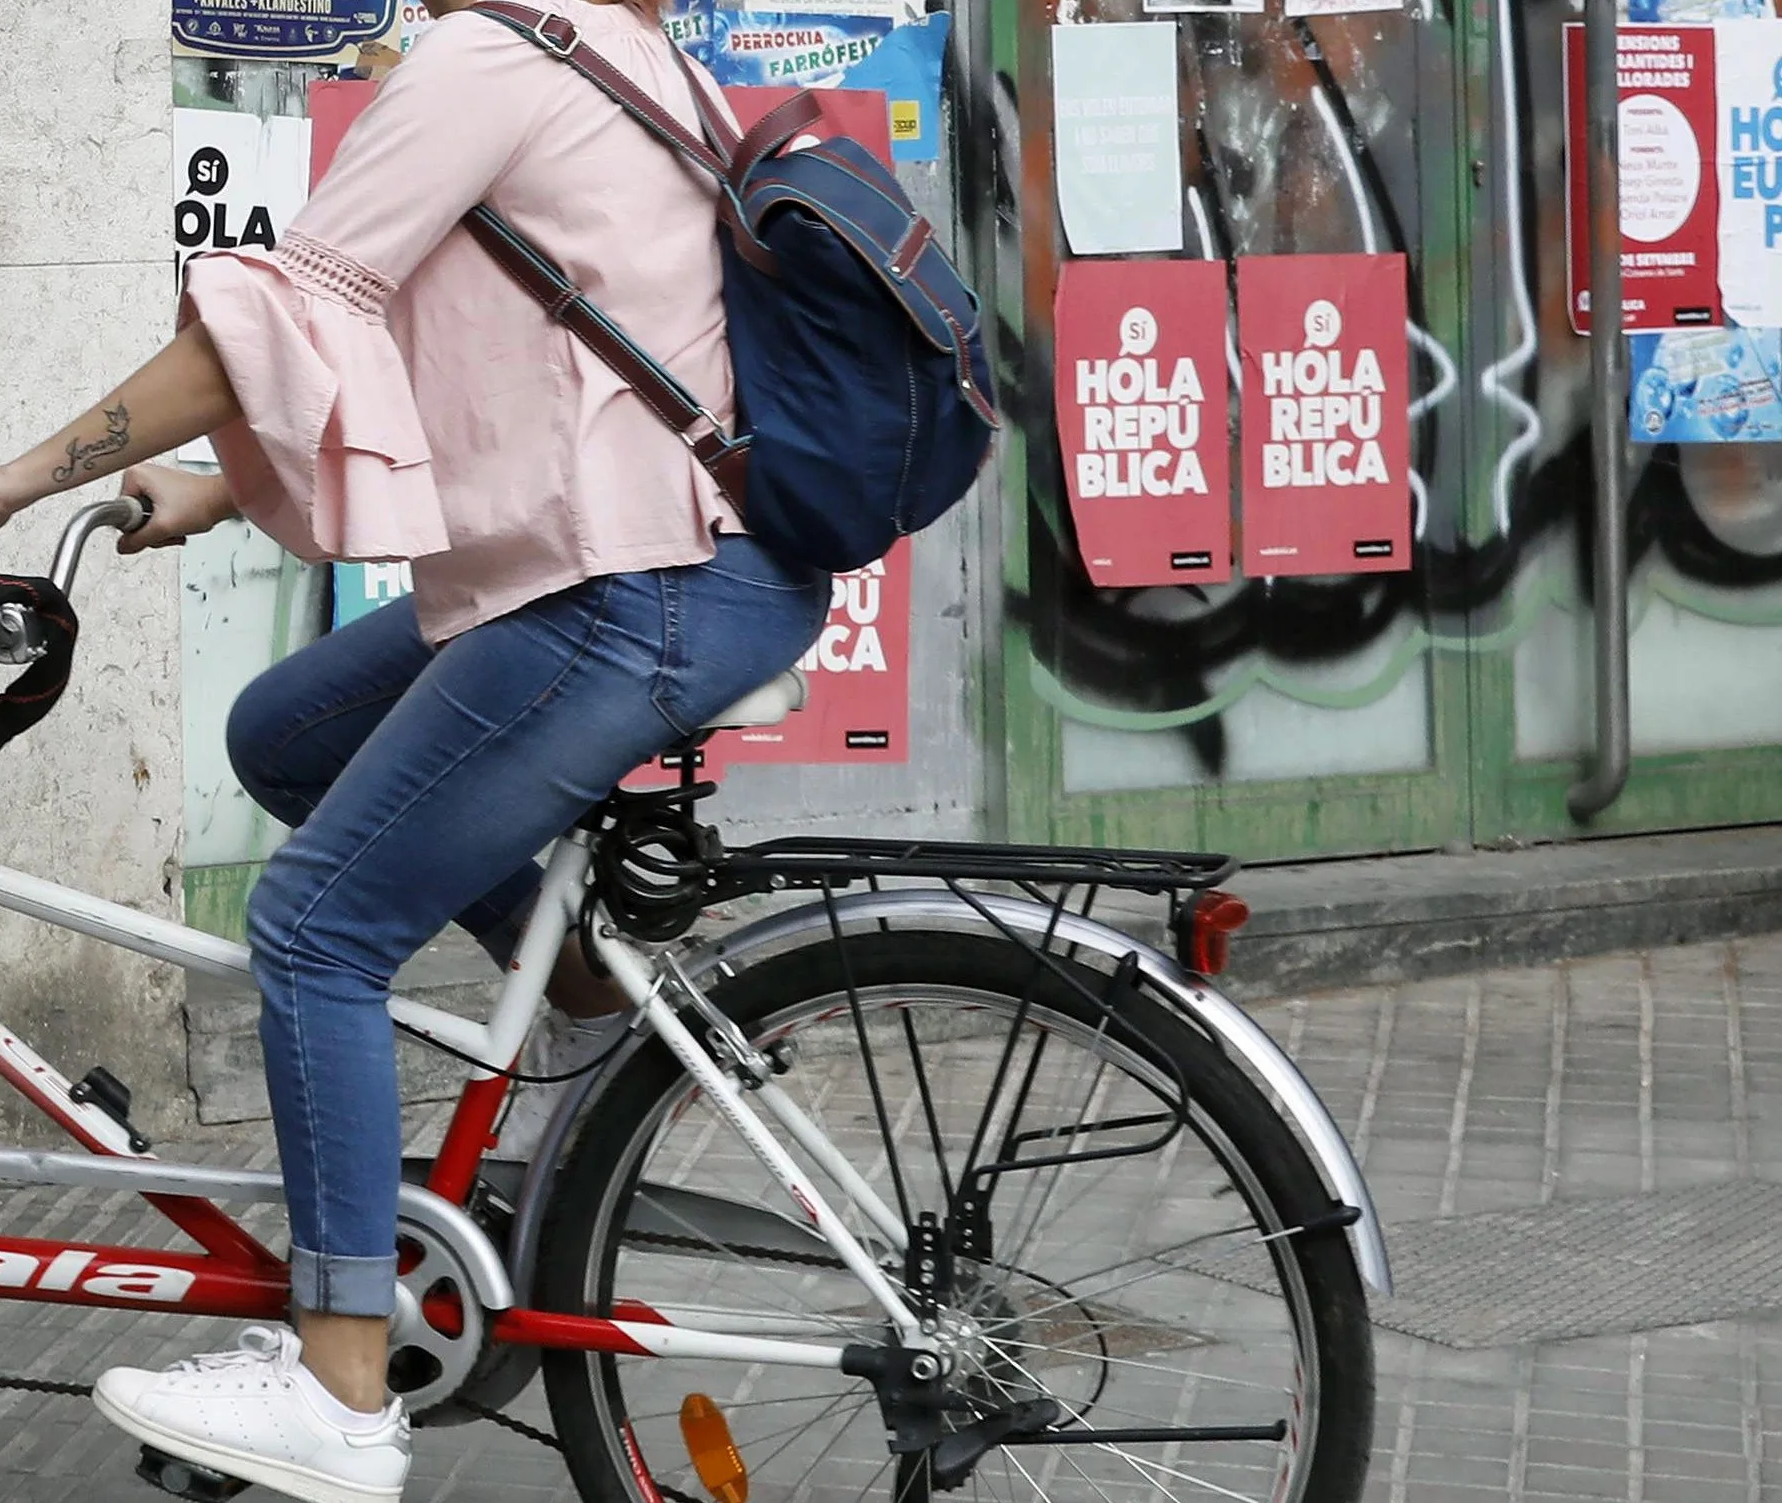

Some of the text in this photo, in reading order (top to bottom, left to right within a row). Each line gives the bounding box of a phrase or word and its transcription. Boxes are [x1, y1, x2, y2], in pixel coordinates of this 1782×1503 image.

[731, 30, 824, 52] PERROCKIA
[1077, 357, 1204, 403] HOLA
[1262, 349, 1385, 395] HOLA
[1085, 398, 1199, 450] REPÚ
[1271, 389, 1381, 441] REPÚ
[1077, 451, 1208, 498] BLICA
[1263, 440, 1389, 487] BLICA
